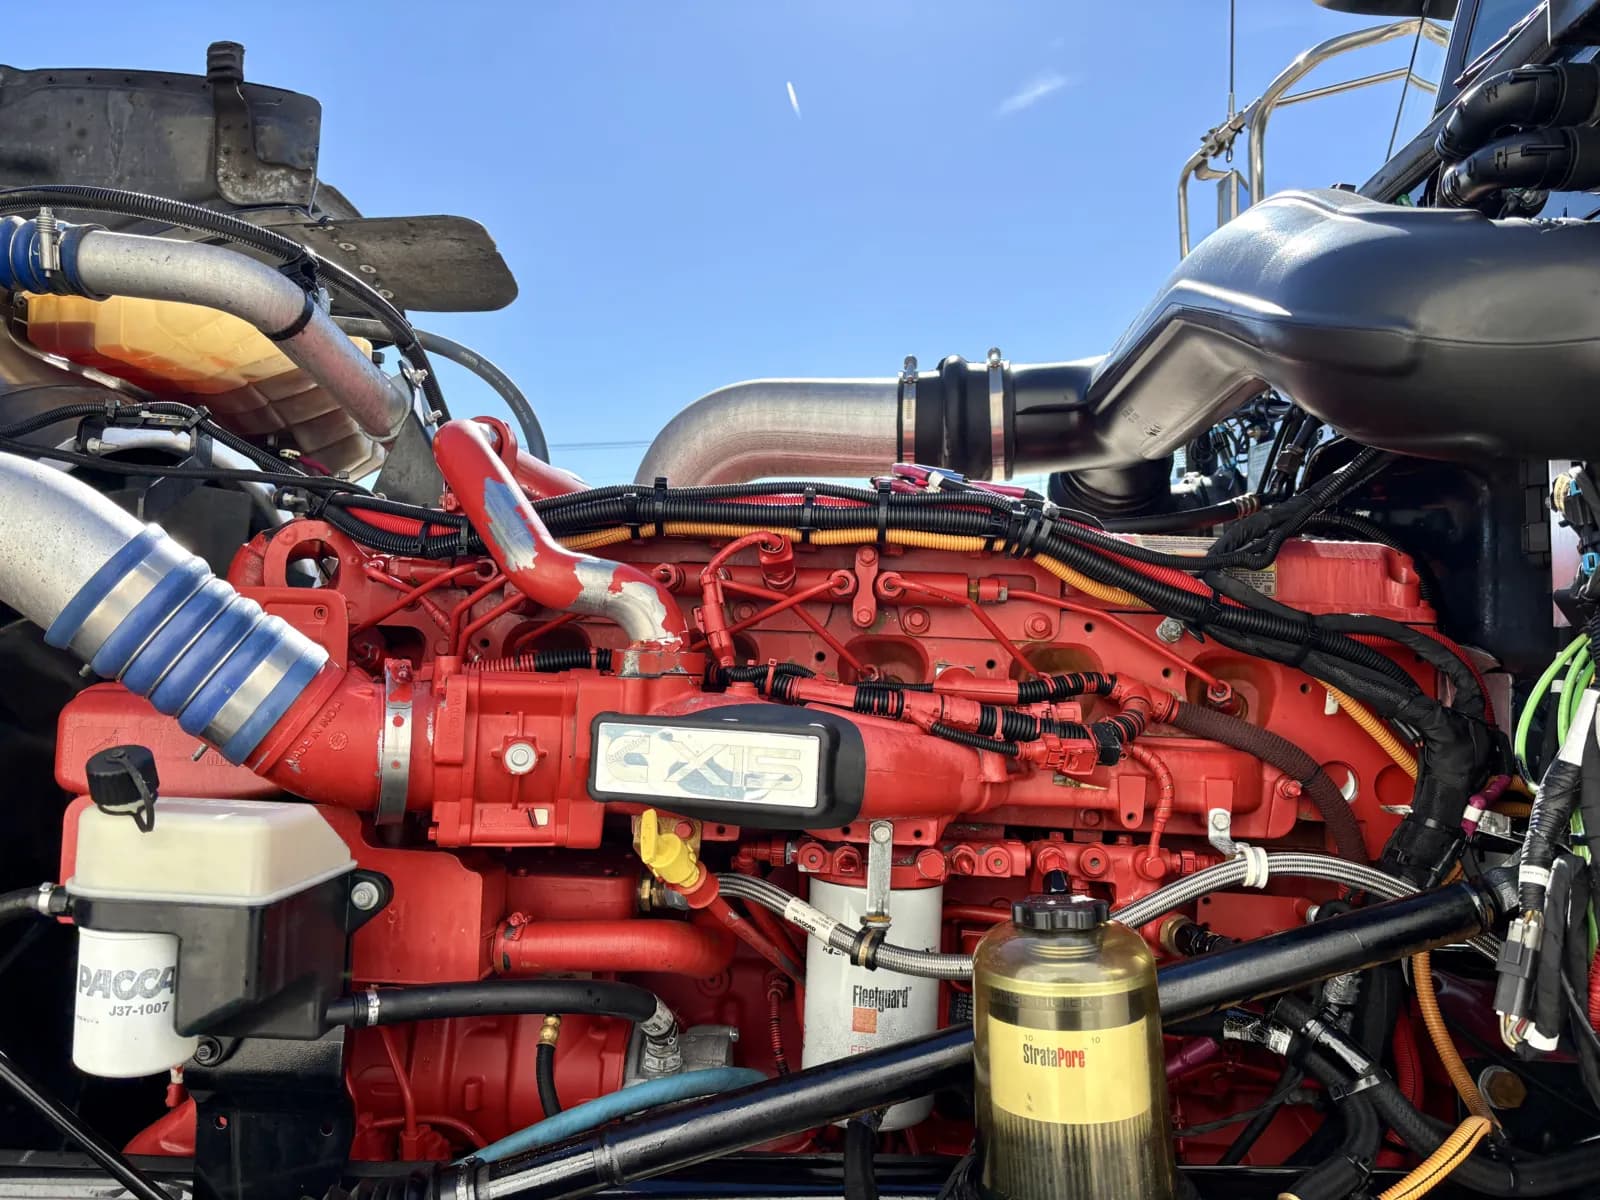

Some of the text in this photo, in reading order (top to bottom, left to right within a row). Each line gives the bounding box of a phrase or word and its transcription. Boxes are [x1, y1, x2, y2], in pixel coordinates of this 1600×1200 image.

[109, 1001, 170, 1017] J37-1007
[853, 985, 908, 1012] Fleetguard
[1023, 1043, 1085, 1068] StrataPore
